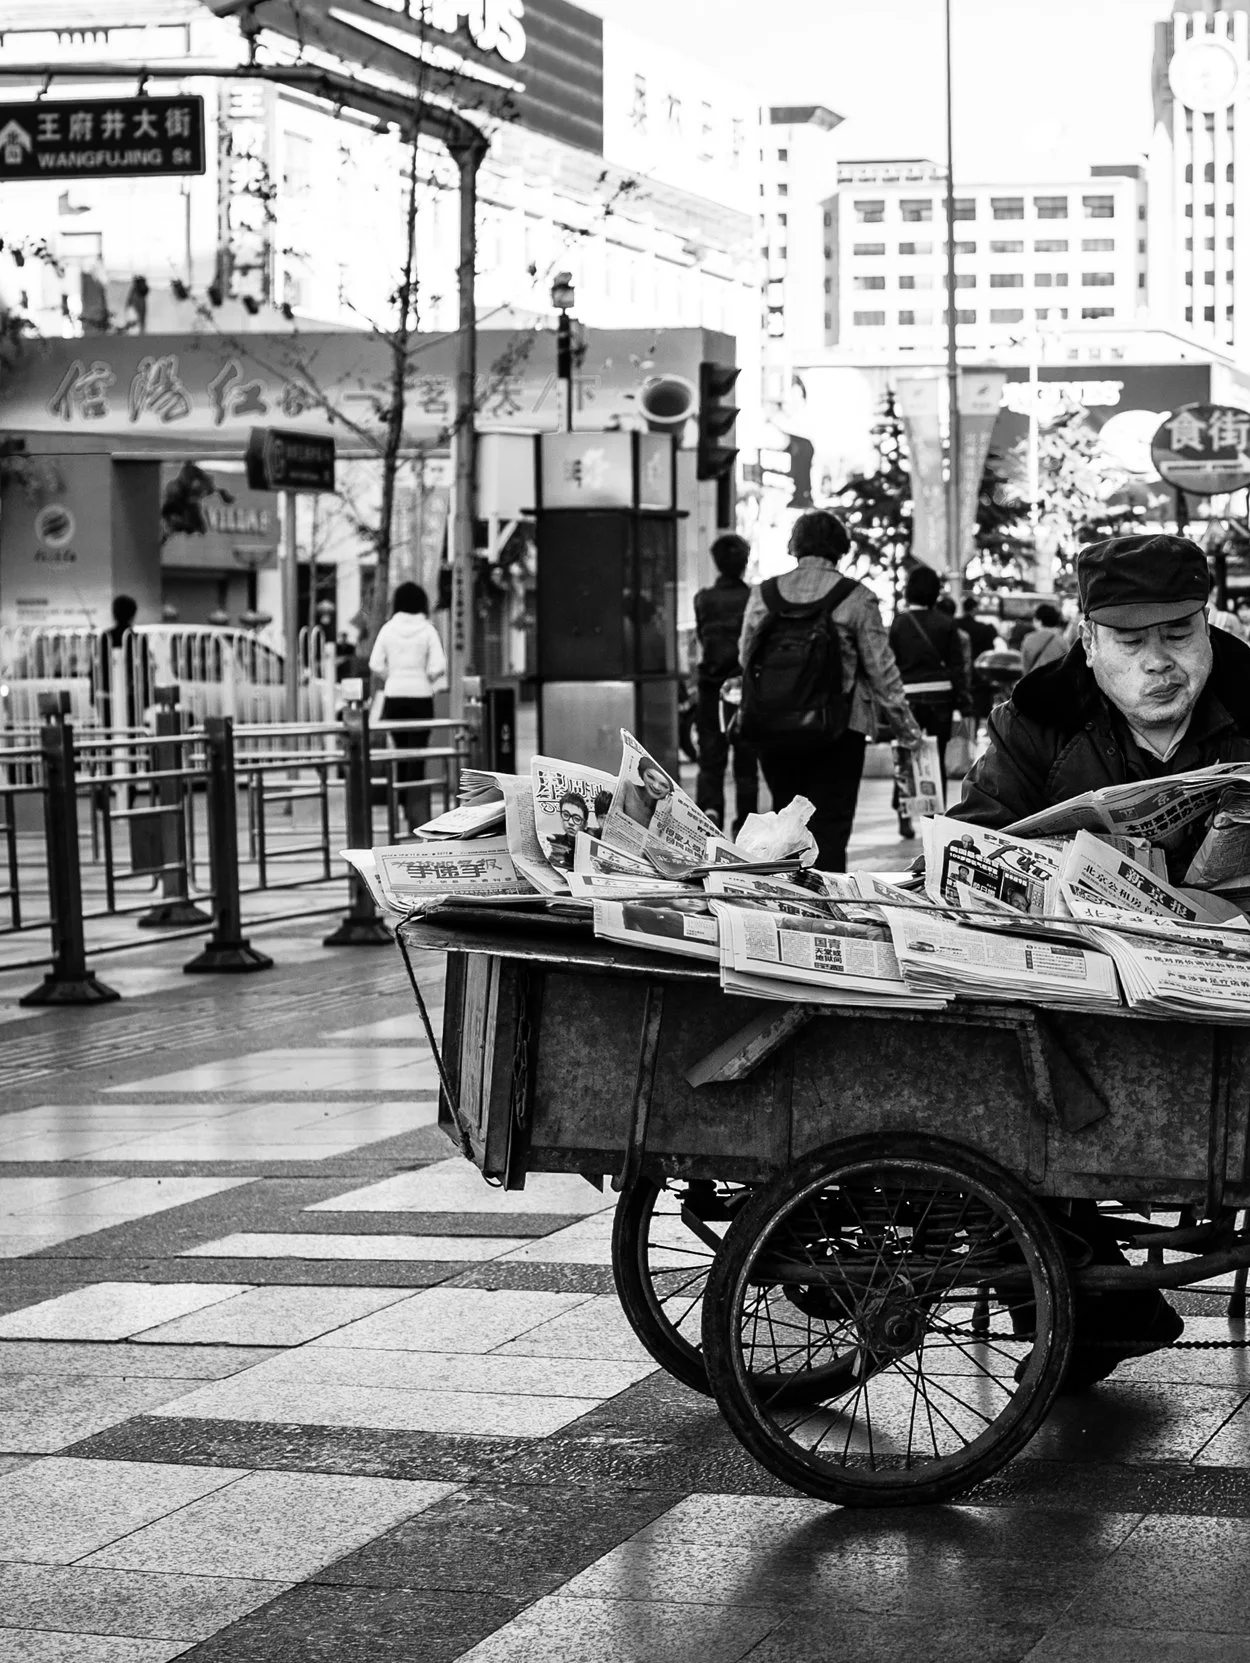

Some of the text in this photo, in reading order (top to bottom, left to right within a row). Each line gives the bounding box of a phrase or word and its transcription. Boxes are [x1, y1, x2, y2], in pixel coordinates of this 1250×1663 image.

[37, 107, 192, 142] 王府井大街
[37, 148, 163, 169] WANGFUJING
[1165, 409, 1250, 452] 食街
[984, 833, 1054, 864] PEOPL
[1084, 864, 1142, 908] 北京公租房
[1125, 867, 1189, 919] 新京报
